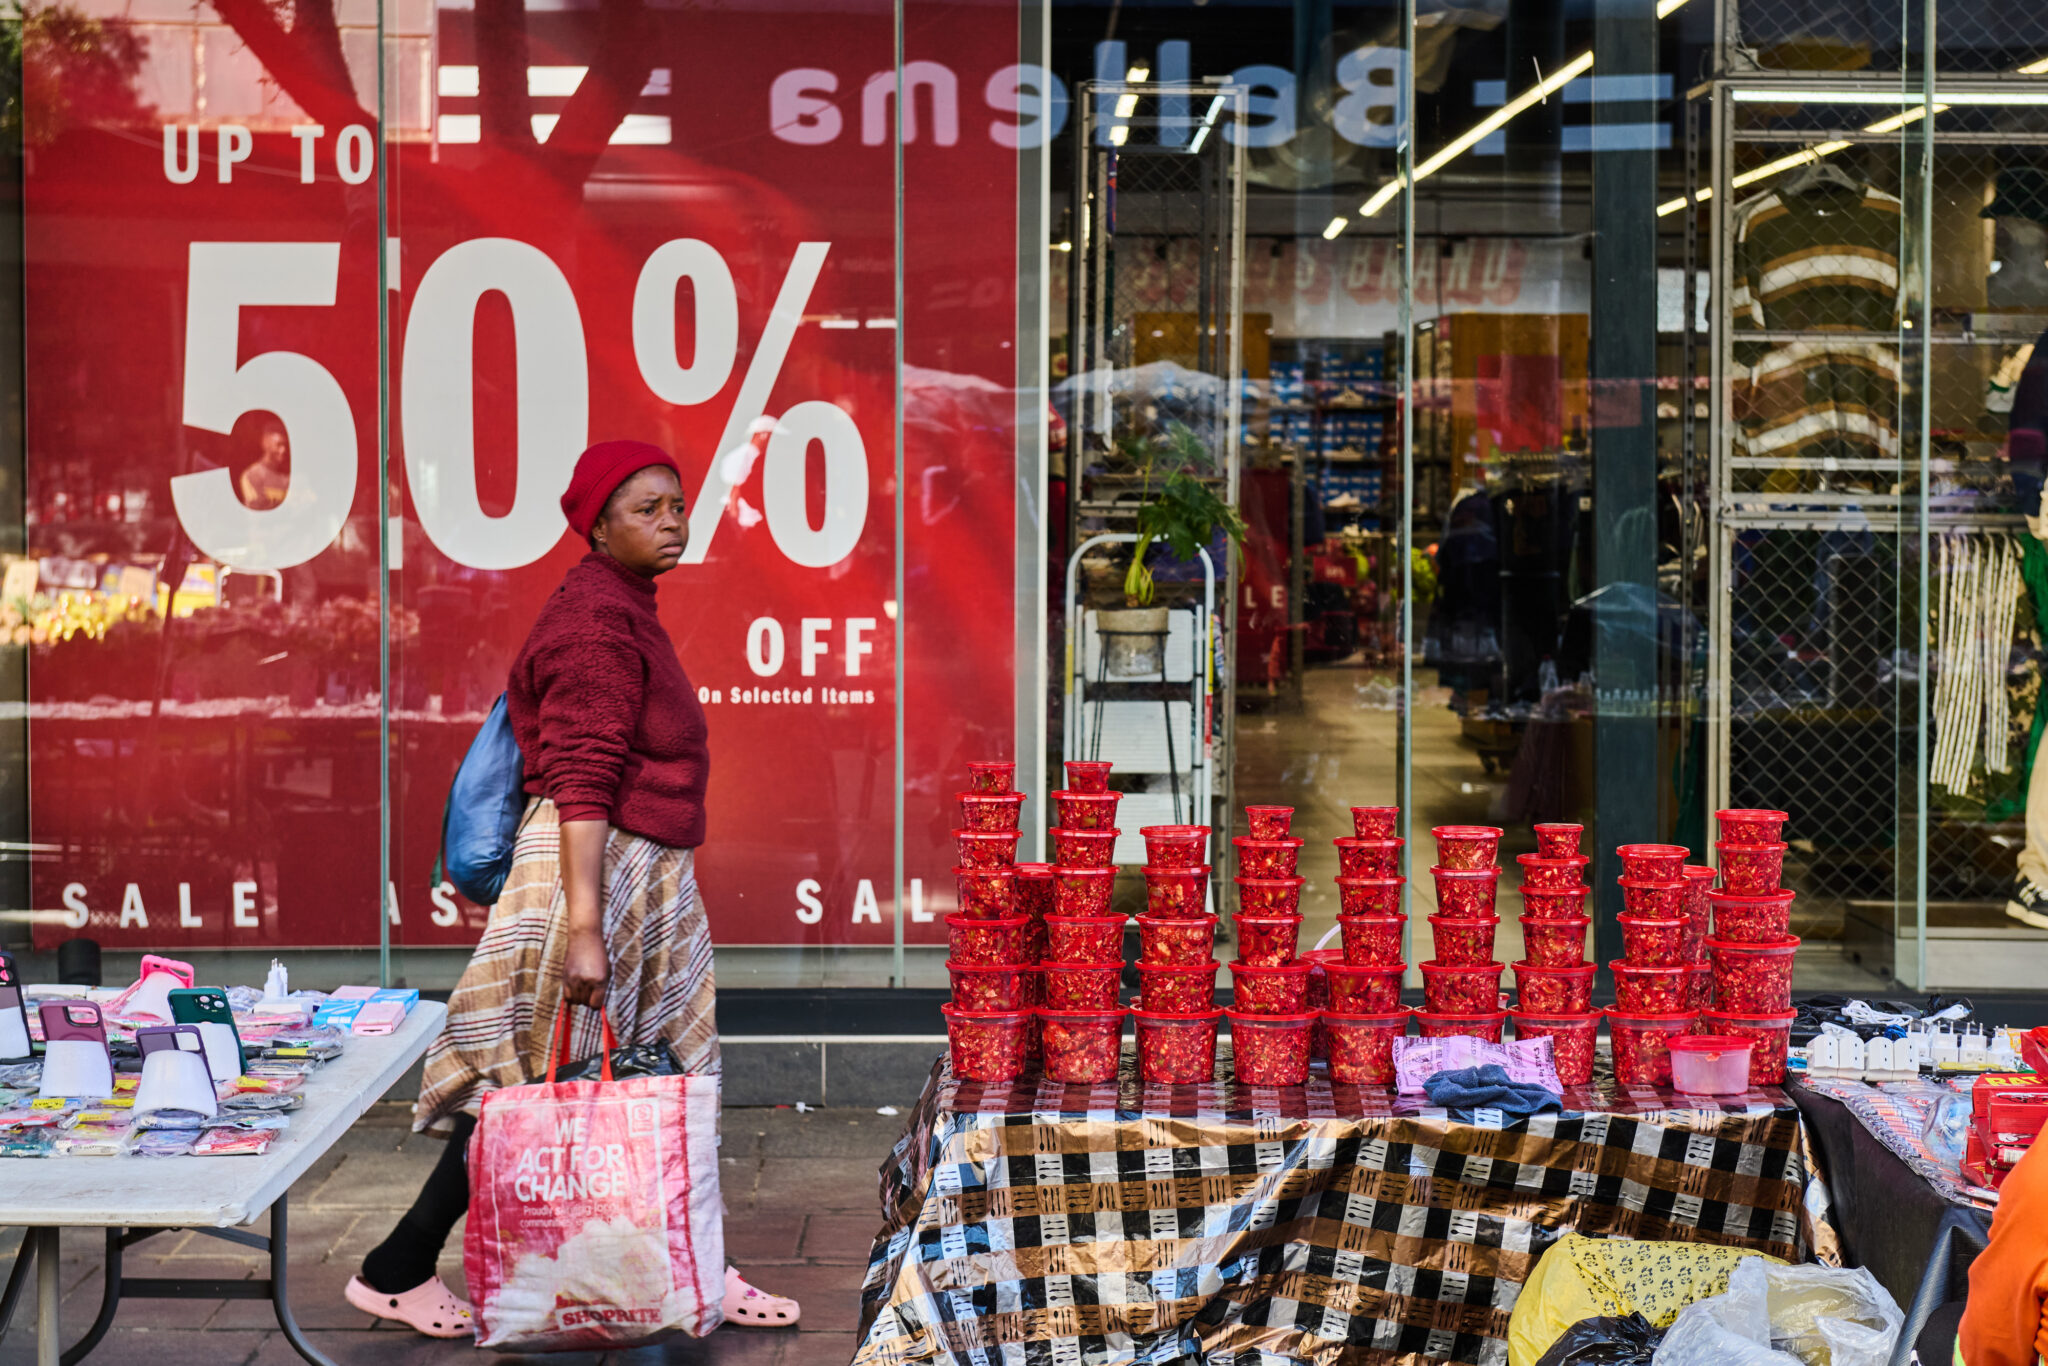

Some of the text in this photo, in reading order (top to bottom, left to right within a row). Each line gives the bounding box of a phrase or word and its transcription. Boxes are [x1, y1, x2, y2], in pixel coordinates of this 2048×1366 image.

[163, 124, 374, 185] UP TO
[170, 237, 869, 571] 50%
[746, 616, 876, 678] OFF
[698, 686, 875, 704] On Selected Items
[62, 882, 259, 929] SALE
[795, 878, 936, 924] SAL
[554, 1117, 587, 1144] WE
[517, 1144, 625, 1174] ACT FOR
[514, 1171, 626, 1202] CHANGE
[562, 1308, 662, 1326] SHOPRITE
